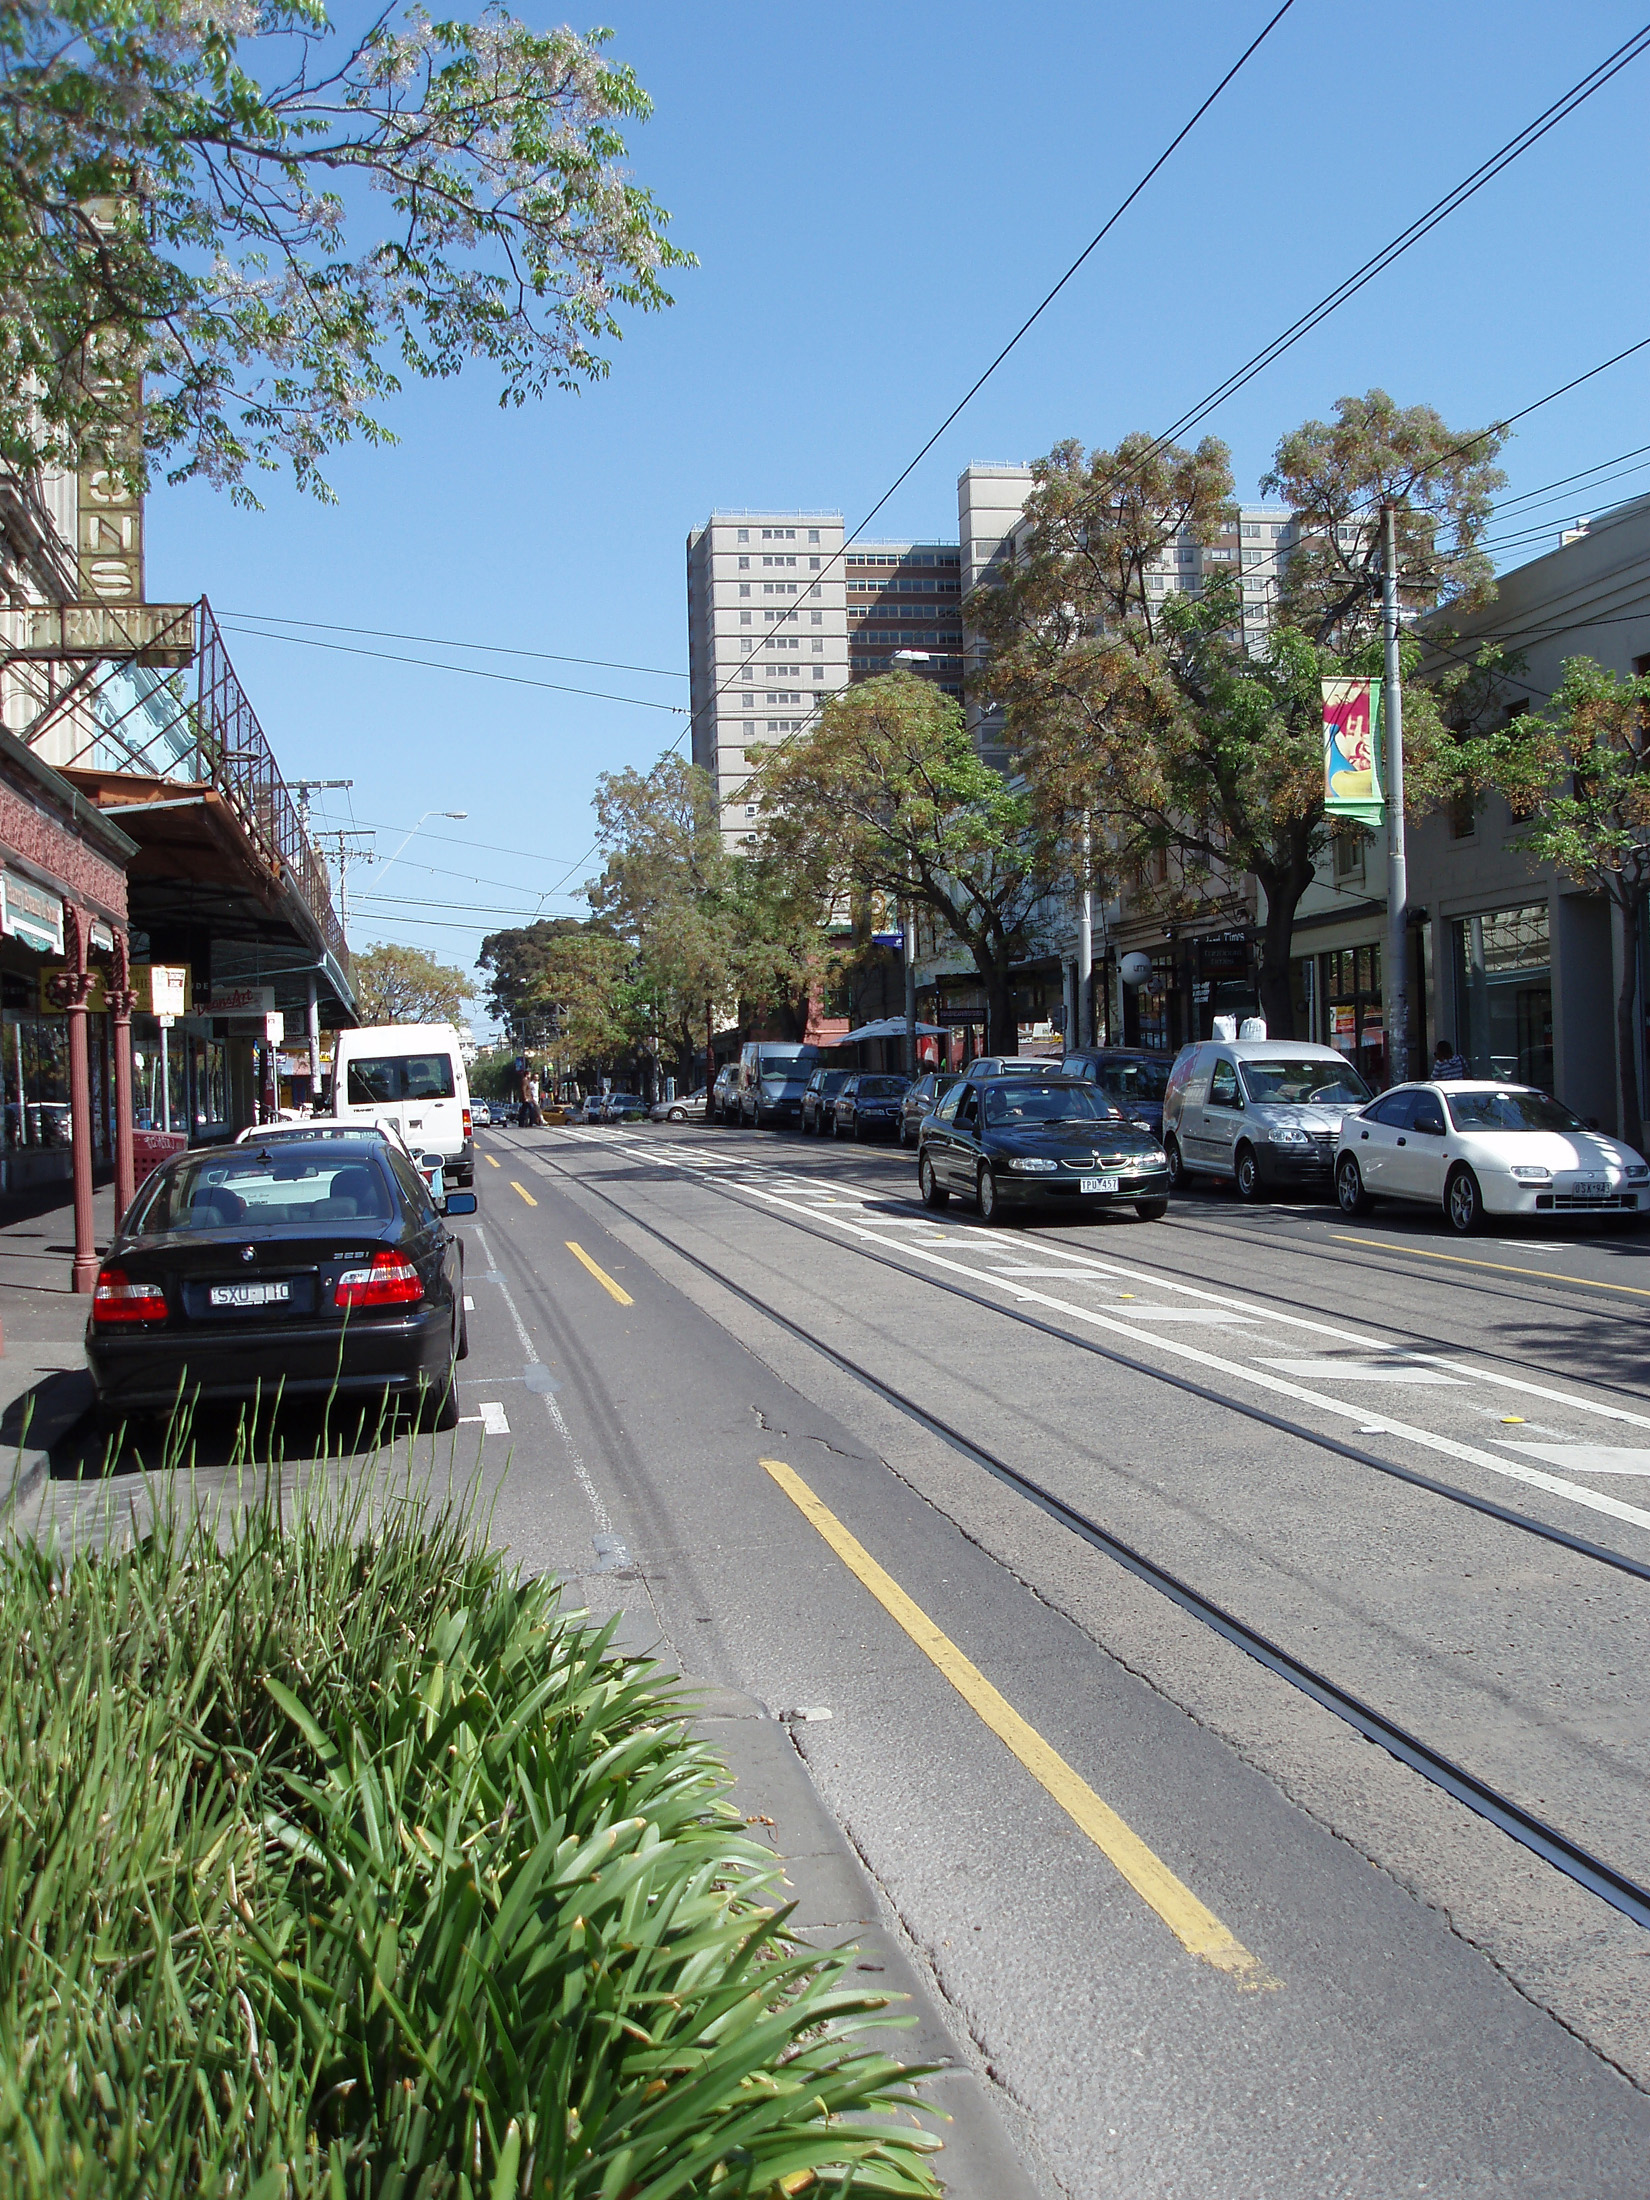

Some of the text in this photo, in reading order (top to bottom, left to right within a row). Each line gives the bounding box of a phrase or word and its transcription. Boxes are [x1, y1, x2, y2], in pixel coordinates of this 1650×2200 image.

[1082, 1179, 1117, 1189] TPU 457
[218, 1285, 290, 1302] SXU 110
